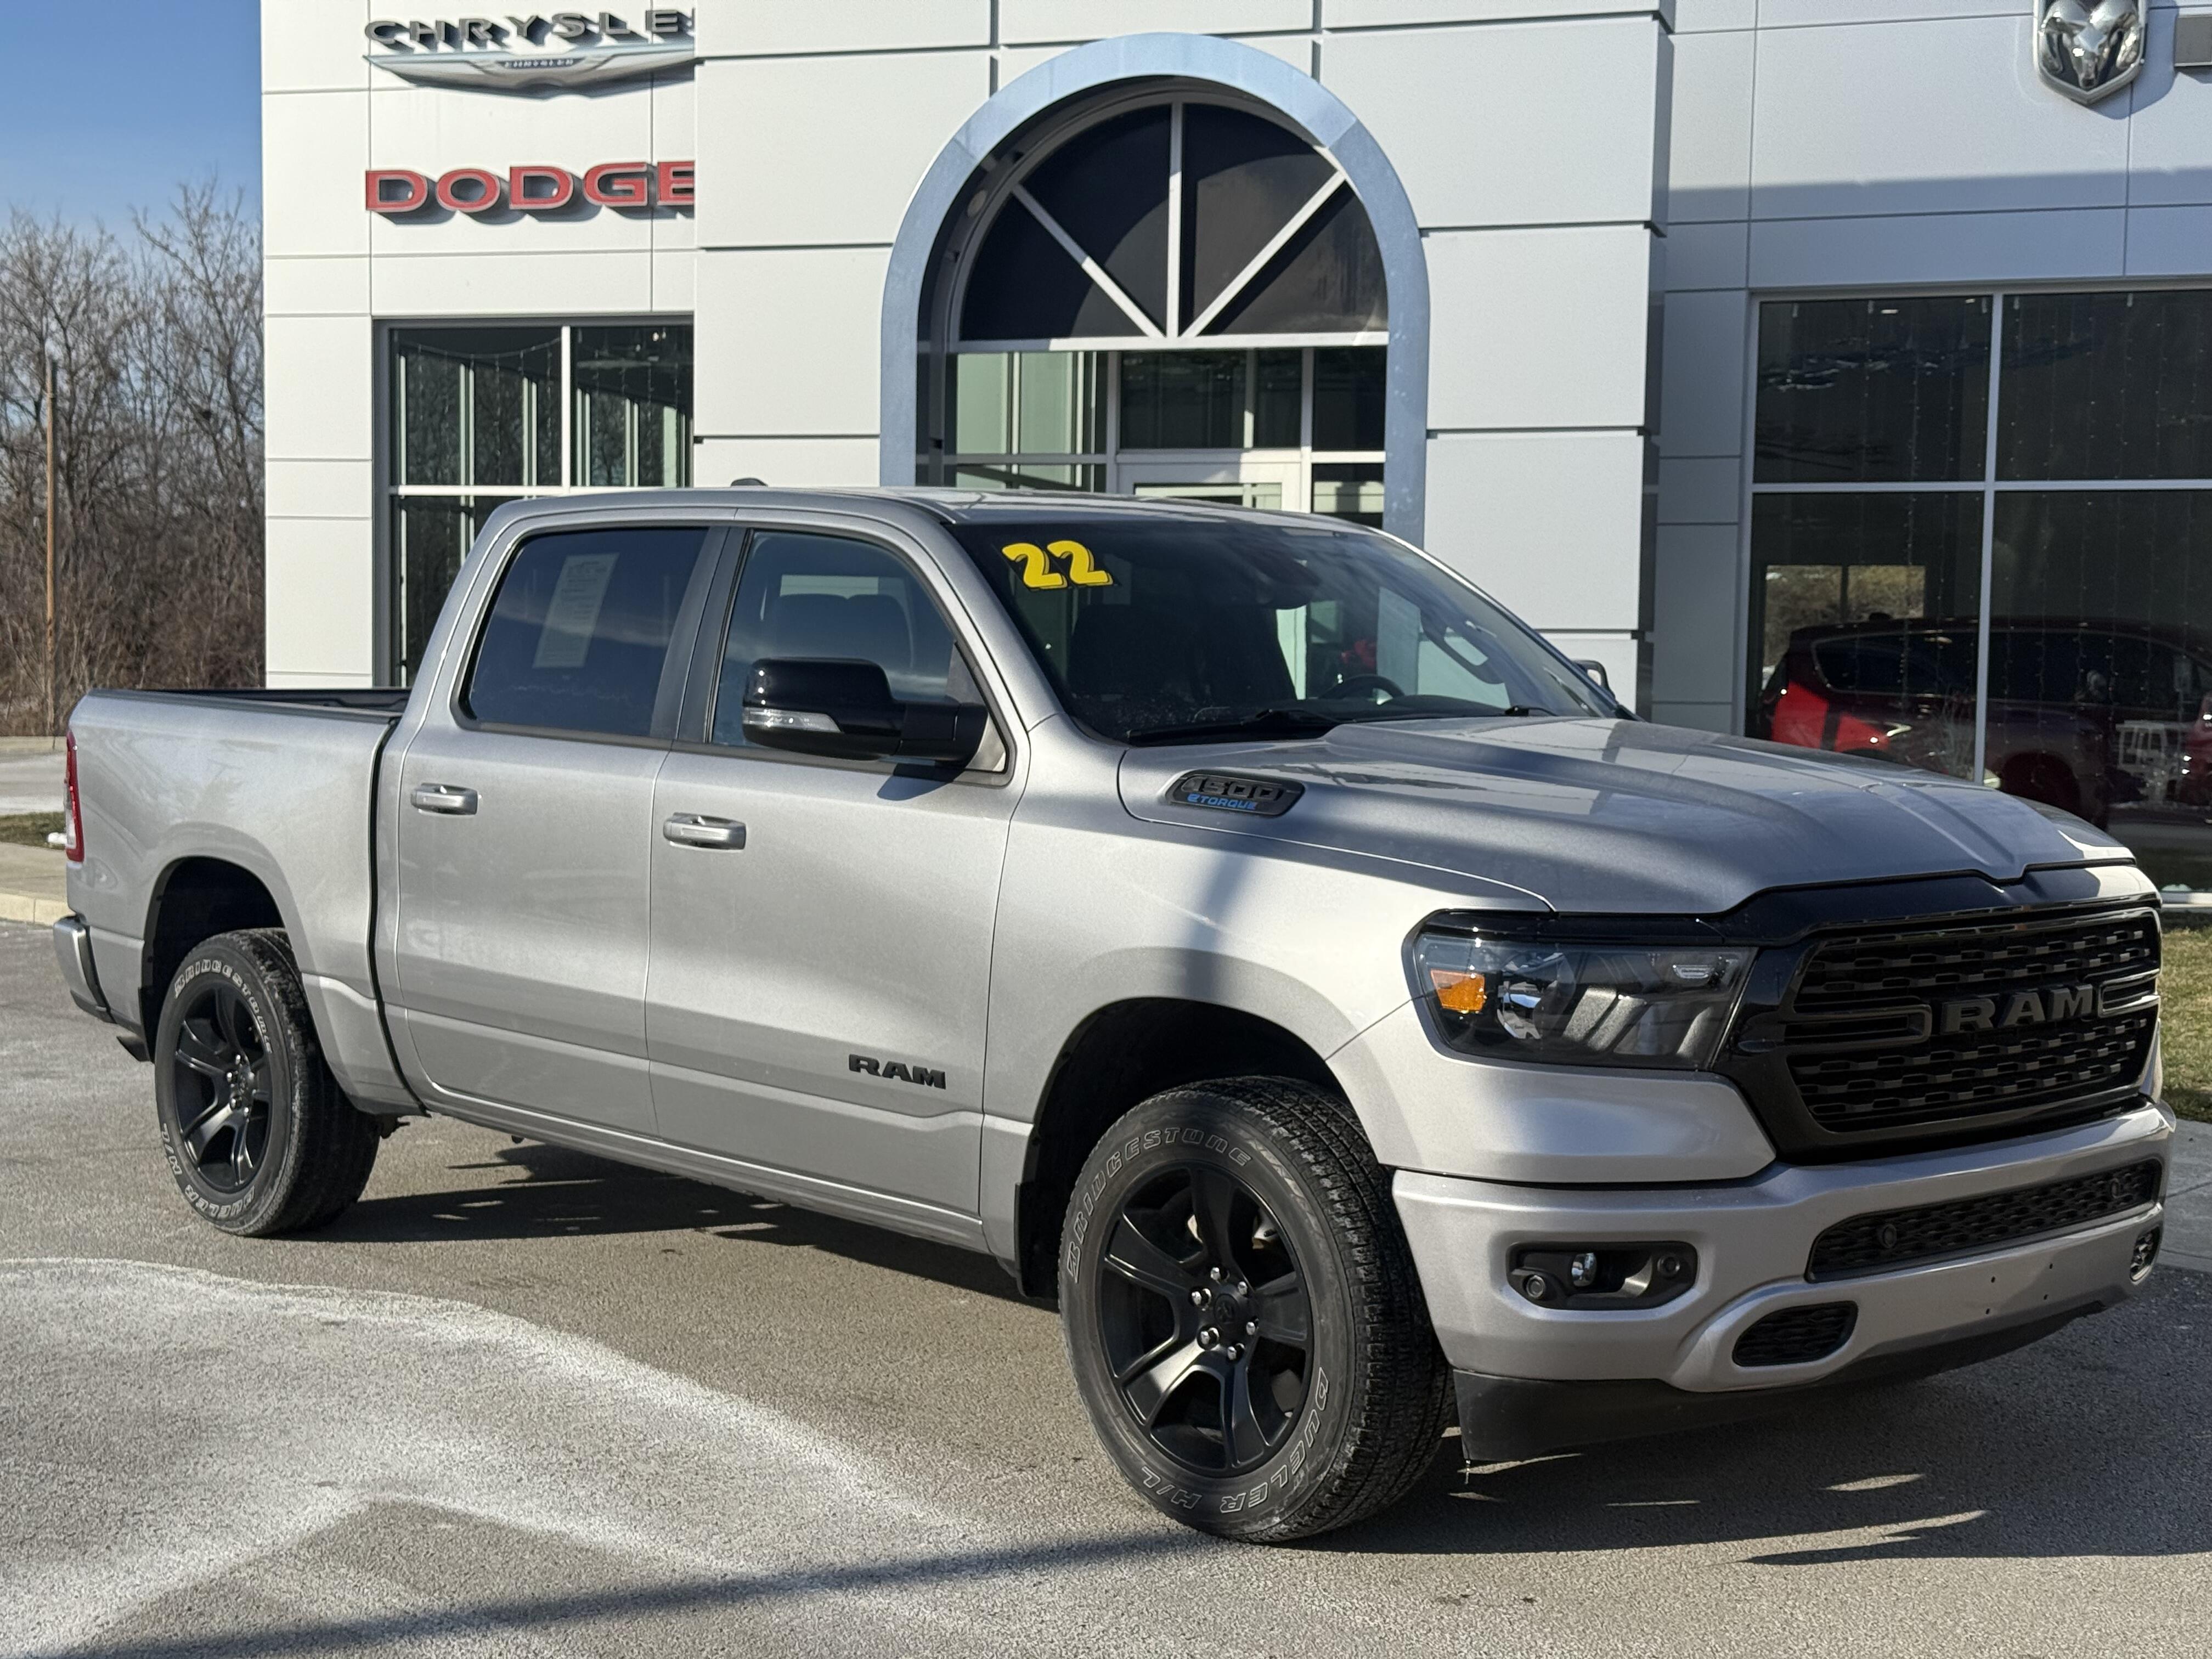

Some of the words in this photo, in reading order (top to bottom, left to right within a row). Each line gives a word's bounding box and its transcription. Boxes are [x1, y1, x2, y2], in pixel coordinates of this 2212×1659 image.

[365, 8, 695, 44] CHRYSLE
[366, 160, 695, 212] DODGE
[1001, 540, 1114, 591] 22
[1181, 775, 1284, 801] 1500
[1939, 984, 2094, 1034] RAM
[849, 1053, 946, 1090] RAM
[1066, 1127, 1252, 1284] BRIDGESTONE
[1219, 1366, 1329, 1514] DUELER
[1141, 1465, 1203, 1509] H/L
